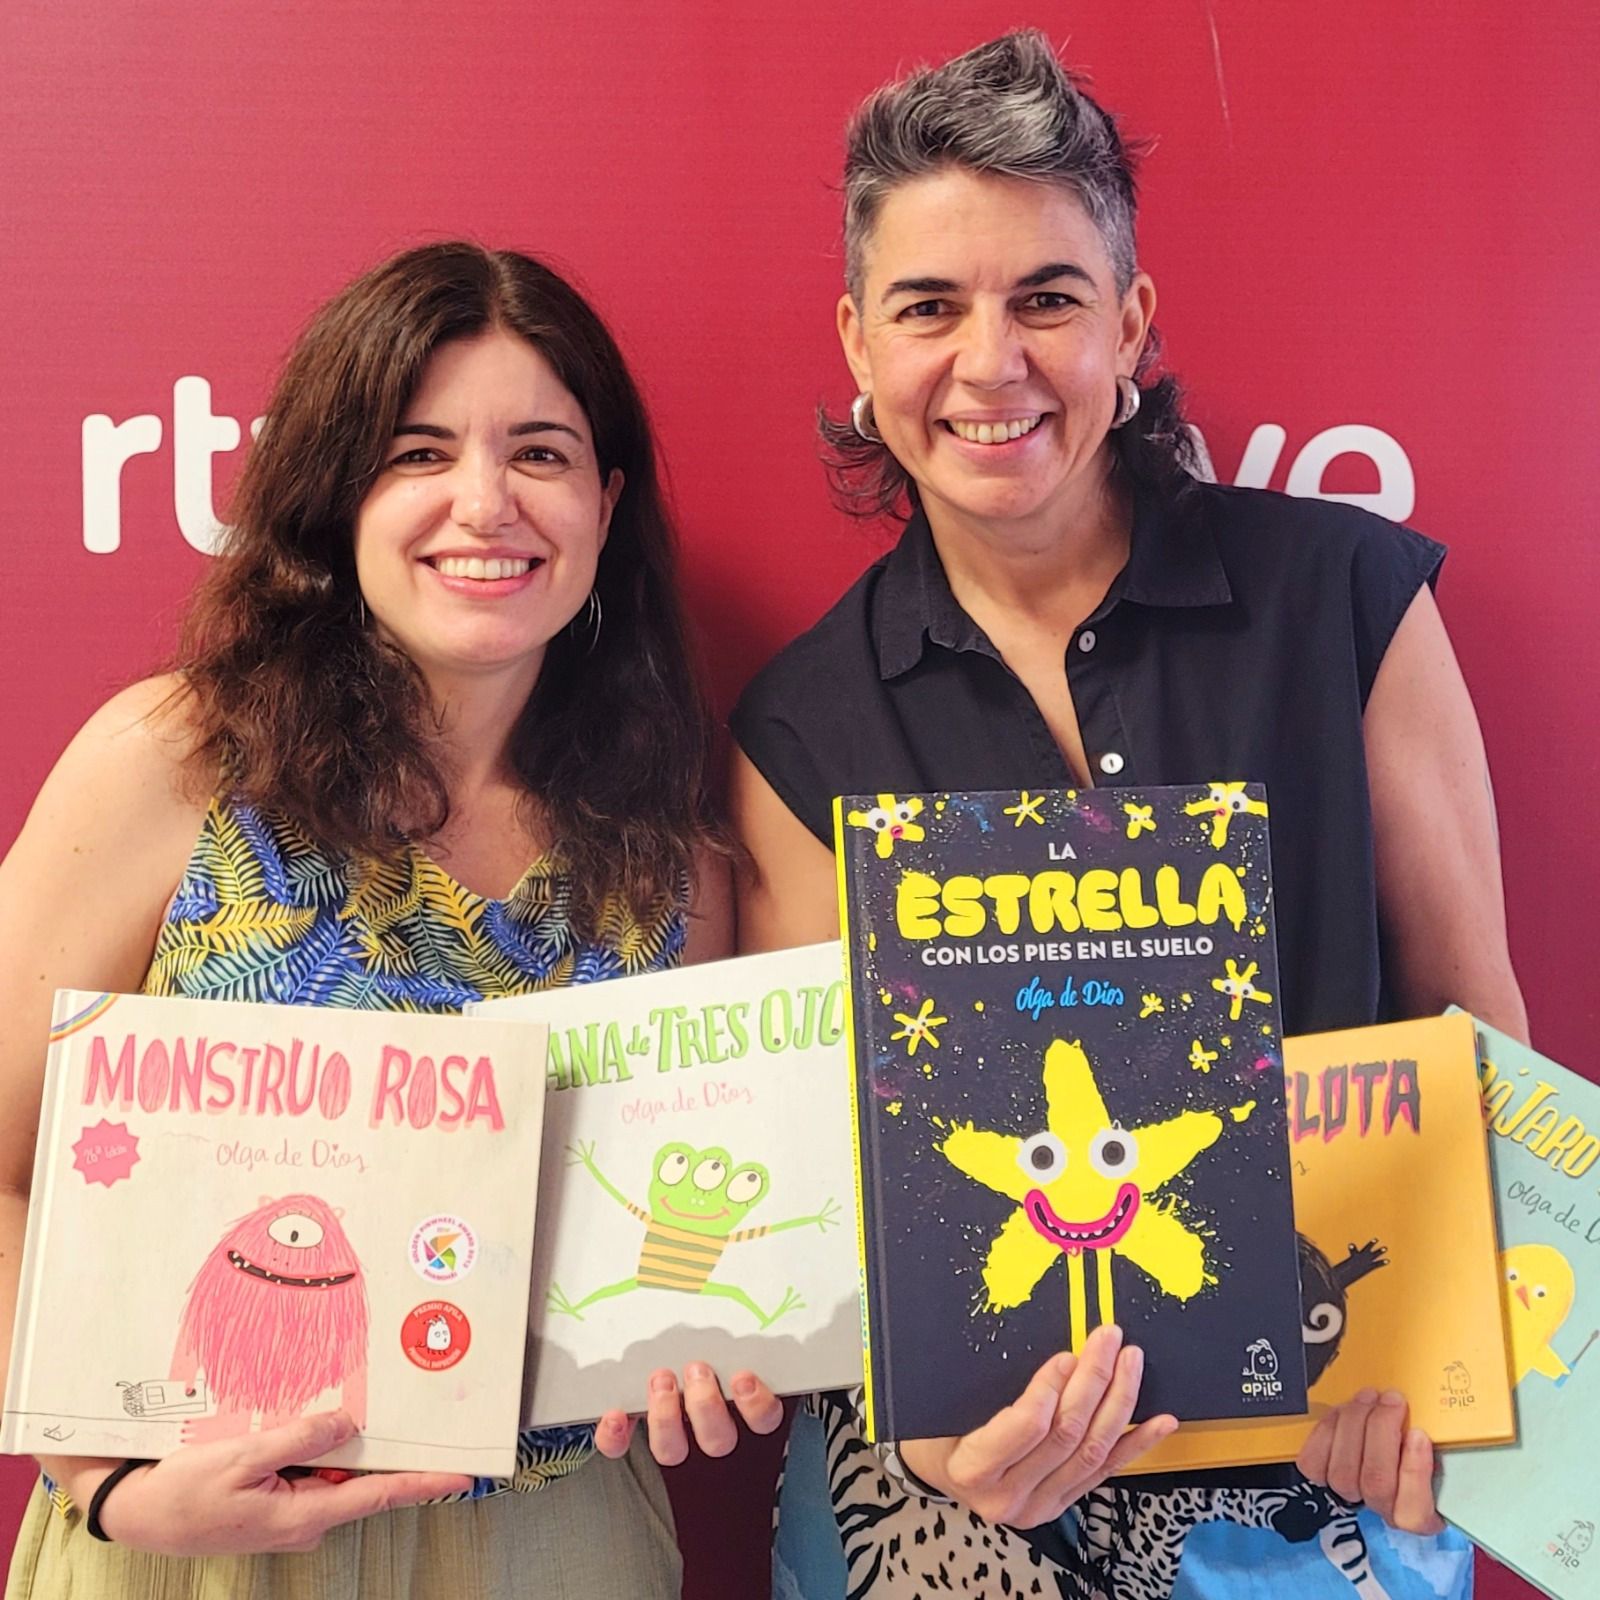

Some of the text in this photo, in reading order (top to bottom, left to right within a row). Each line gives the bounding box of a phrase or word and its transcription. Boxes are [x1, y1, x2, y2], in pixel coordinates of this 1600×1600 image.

[81, 375, 268, 556] rt
[1048, 842, 1077, 860] LA
[896, 862, 1247, 940] ESTRELLA
[921, 937, 1214, 966] CON LOS PIES EN EL SUELO
[1016, 976, 1124, 1021] Olga de Dios
[545, 979, 847, 1092] ANA de TRES OJO
[82, 1034, 506, 1133] MONSTRUO ROSA
[621, 1081, 753, 1125] Olga de Dios
[1285, 1058, 1422, 1145] LOTA
[216, 1138, 370, 1174] Olga de Dios
[1507, 1180, 1552, 1215] Olga
[1554, 1203, 1581, 1234] de
